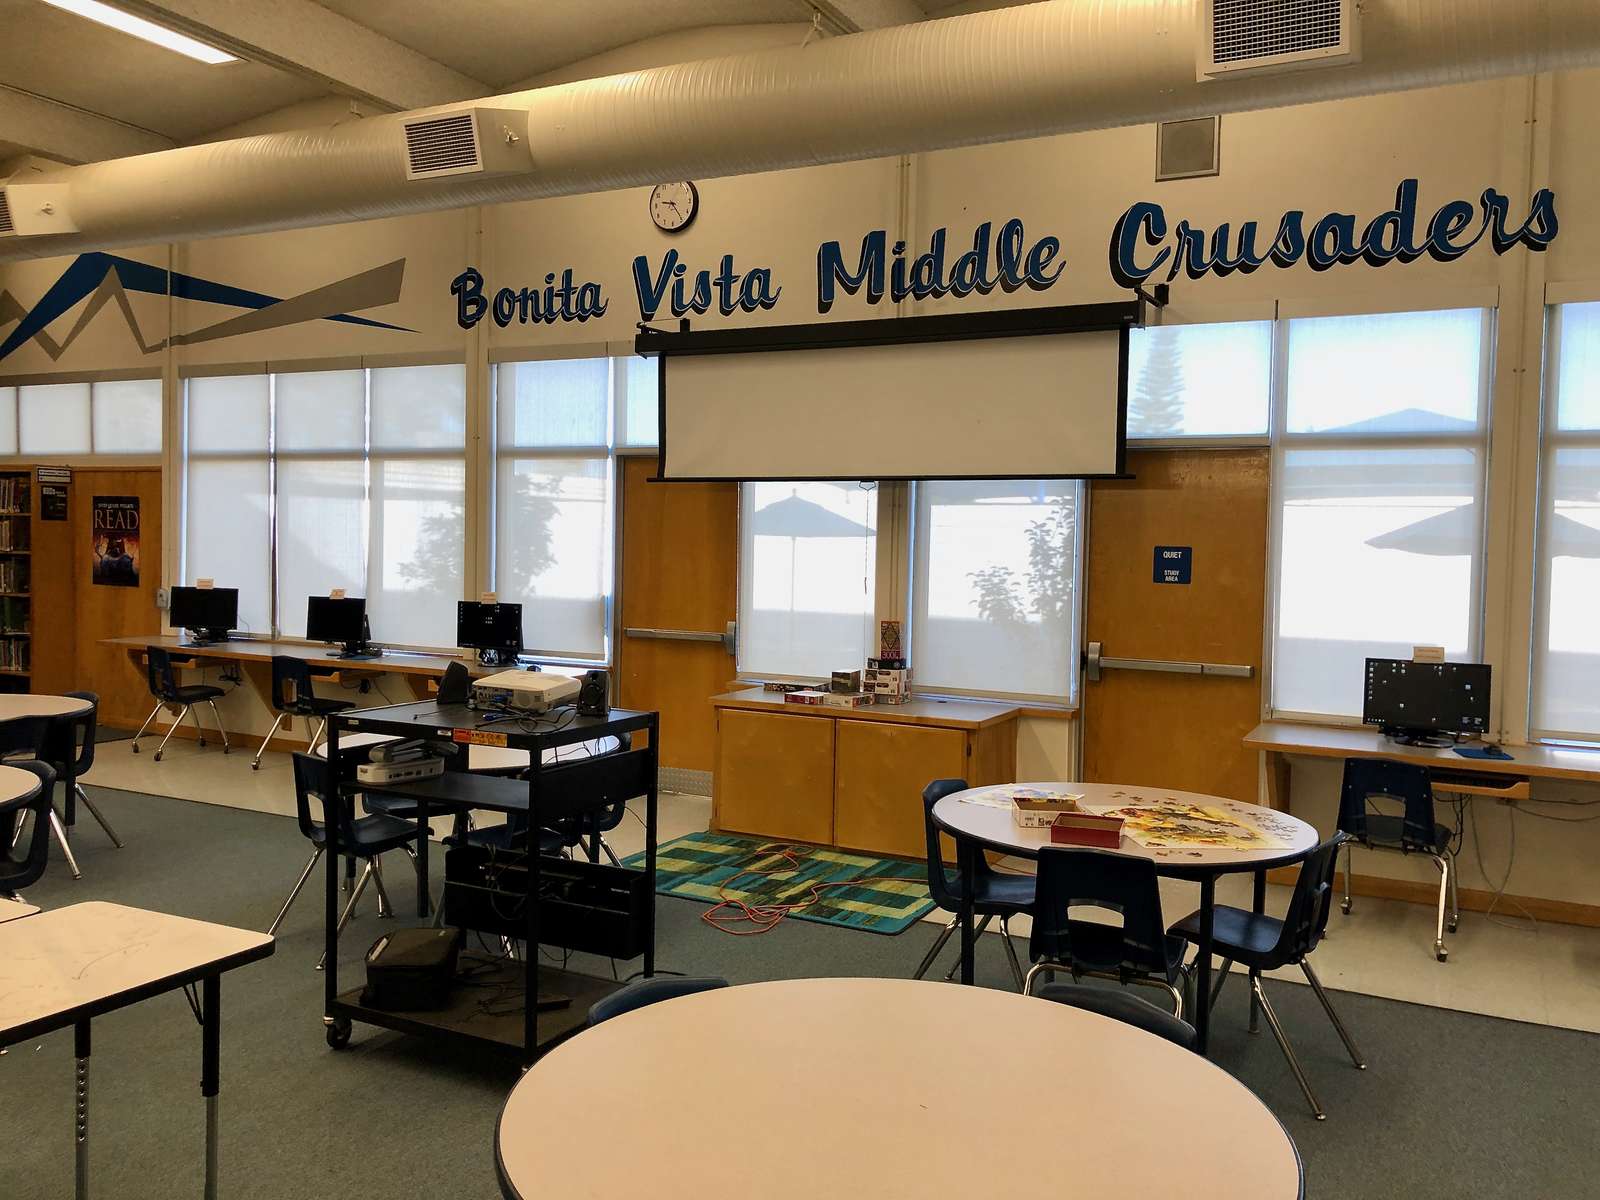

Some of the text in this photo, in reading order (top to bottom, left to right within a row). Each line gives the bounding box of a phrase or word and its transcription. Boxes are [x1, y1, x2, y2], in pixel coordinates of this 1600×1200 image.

[451, 178, 1559, 330] Bonita Vista Middle Crusaders
[94, 509, 139, 529] READ
[1163, 551, 1182, 559] QUIET
